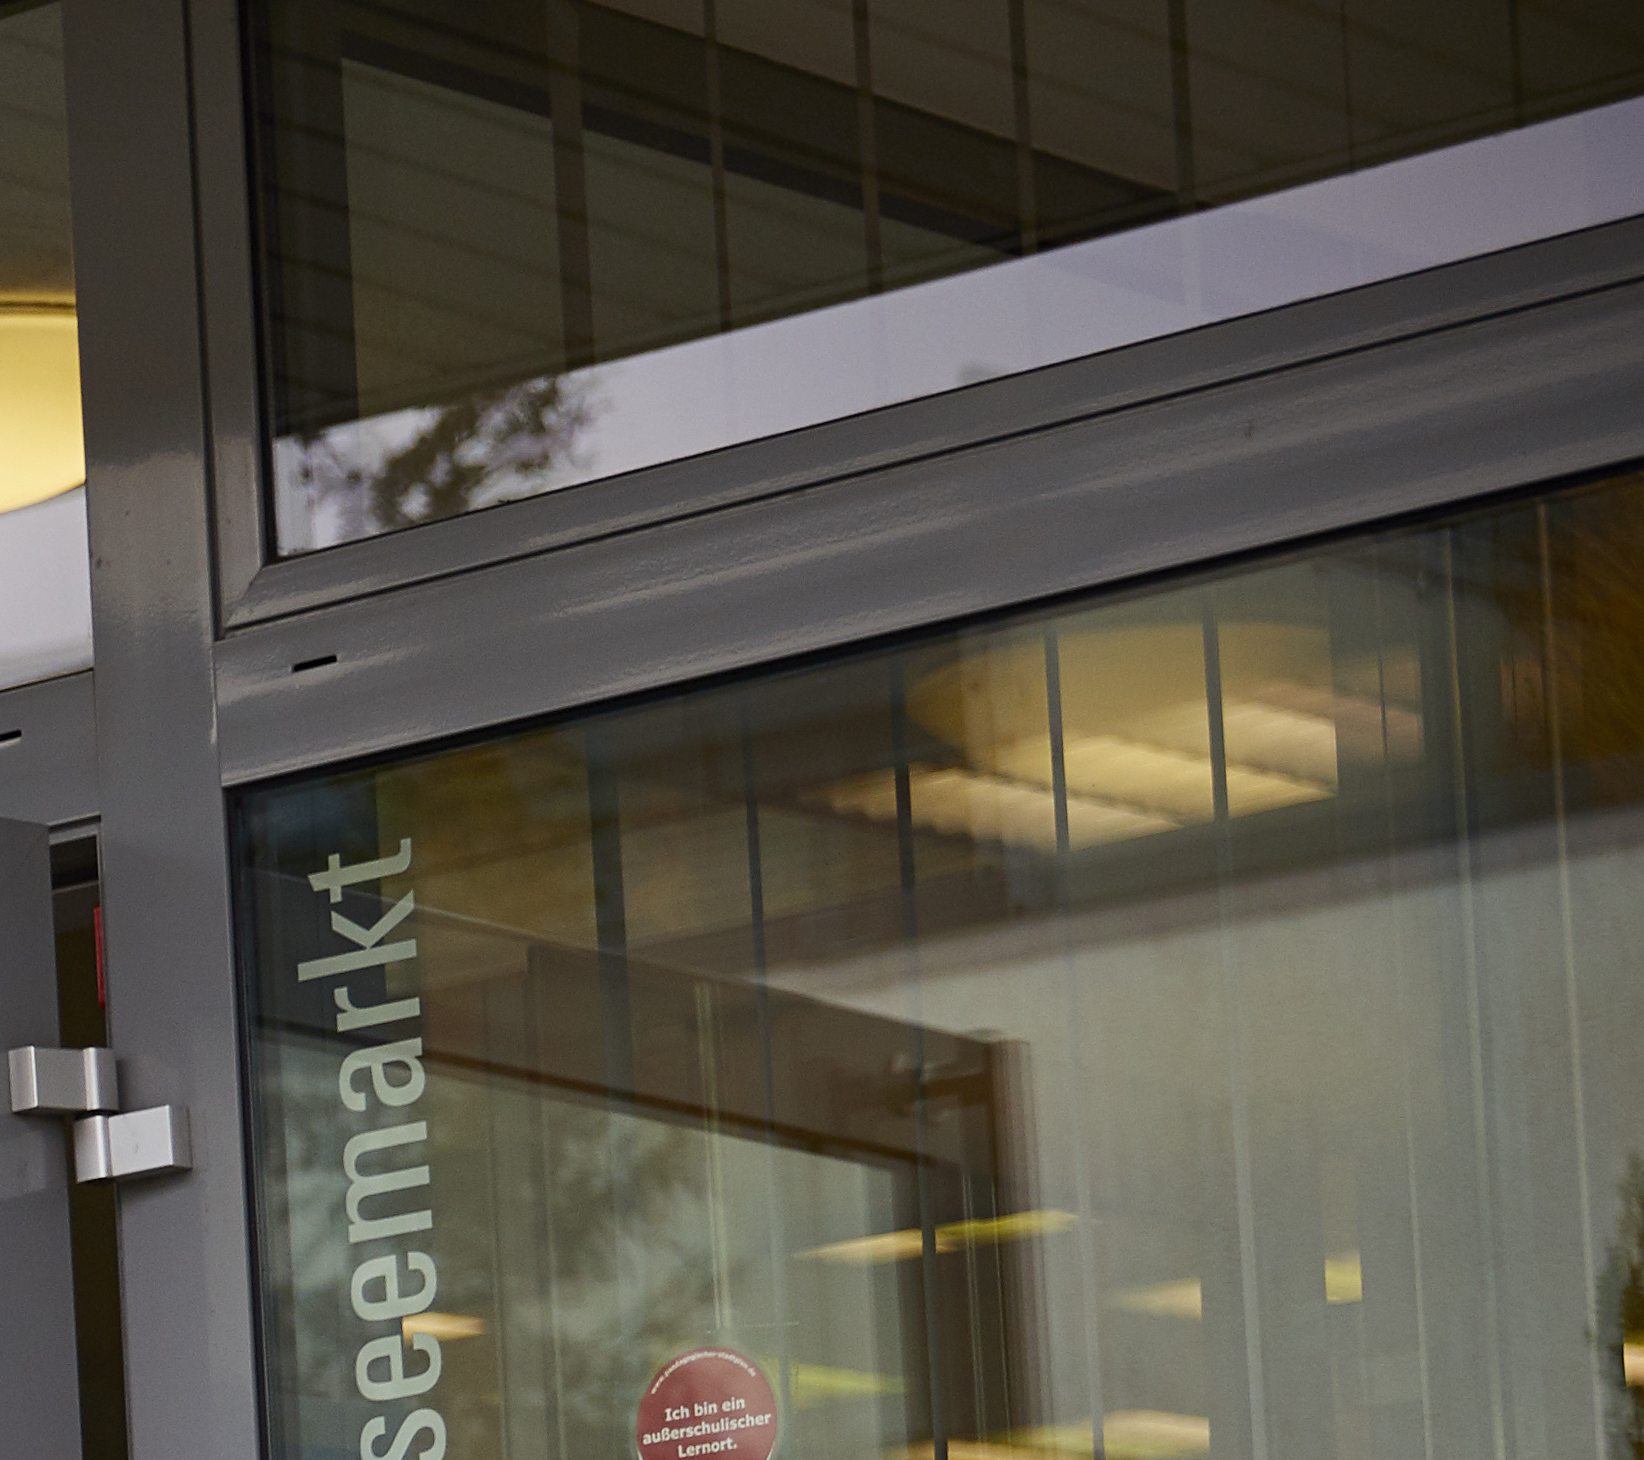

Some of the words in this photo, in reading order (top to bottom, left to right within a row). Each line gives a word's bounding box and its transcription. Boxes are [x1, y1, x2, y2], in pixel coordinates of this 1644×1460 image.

[664, 1405, 689, 1421] Ich
[694, 1401, 717, 1416] bin
[722, 1397, 745, 1412] ein
[642, 1412, 771, 1445] außerschulischer
[677, 1437, 738, 1458] Lernort.
